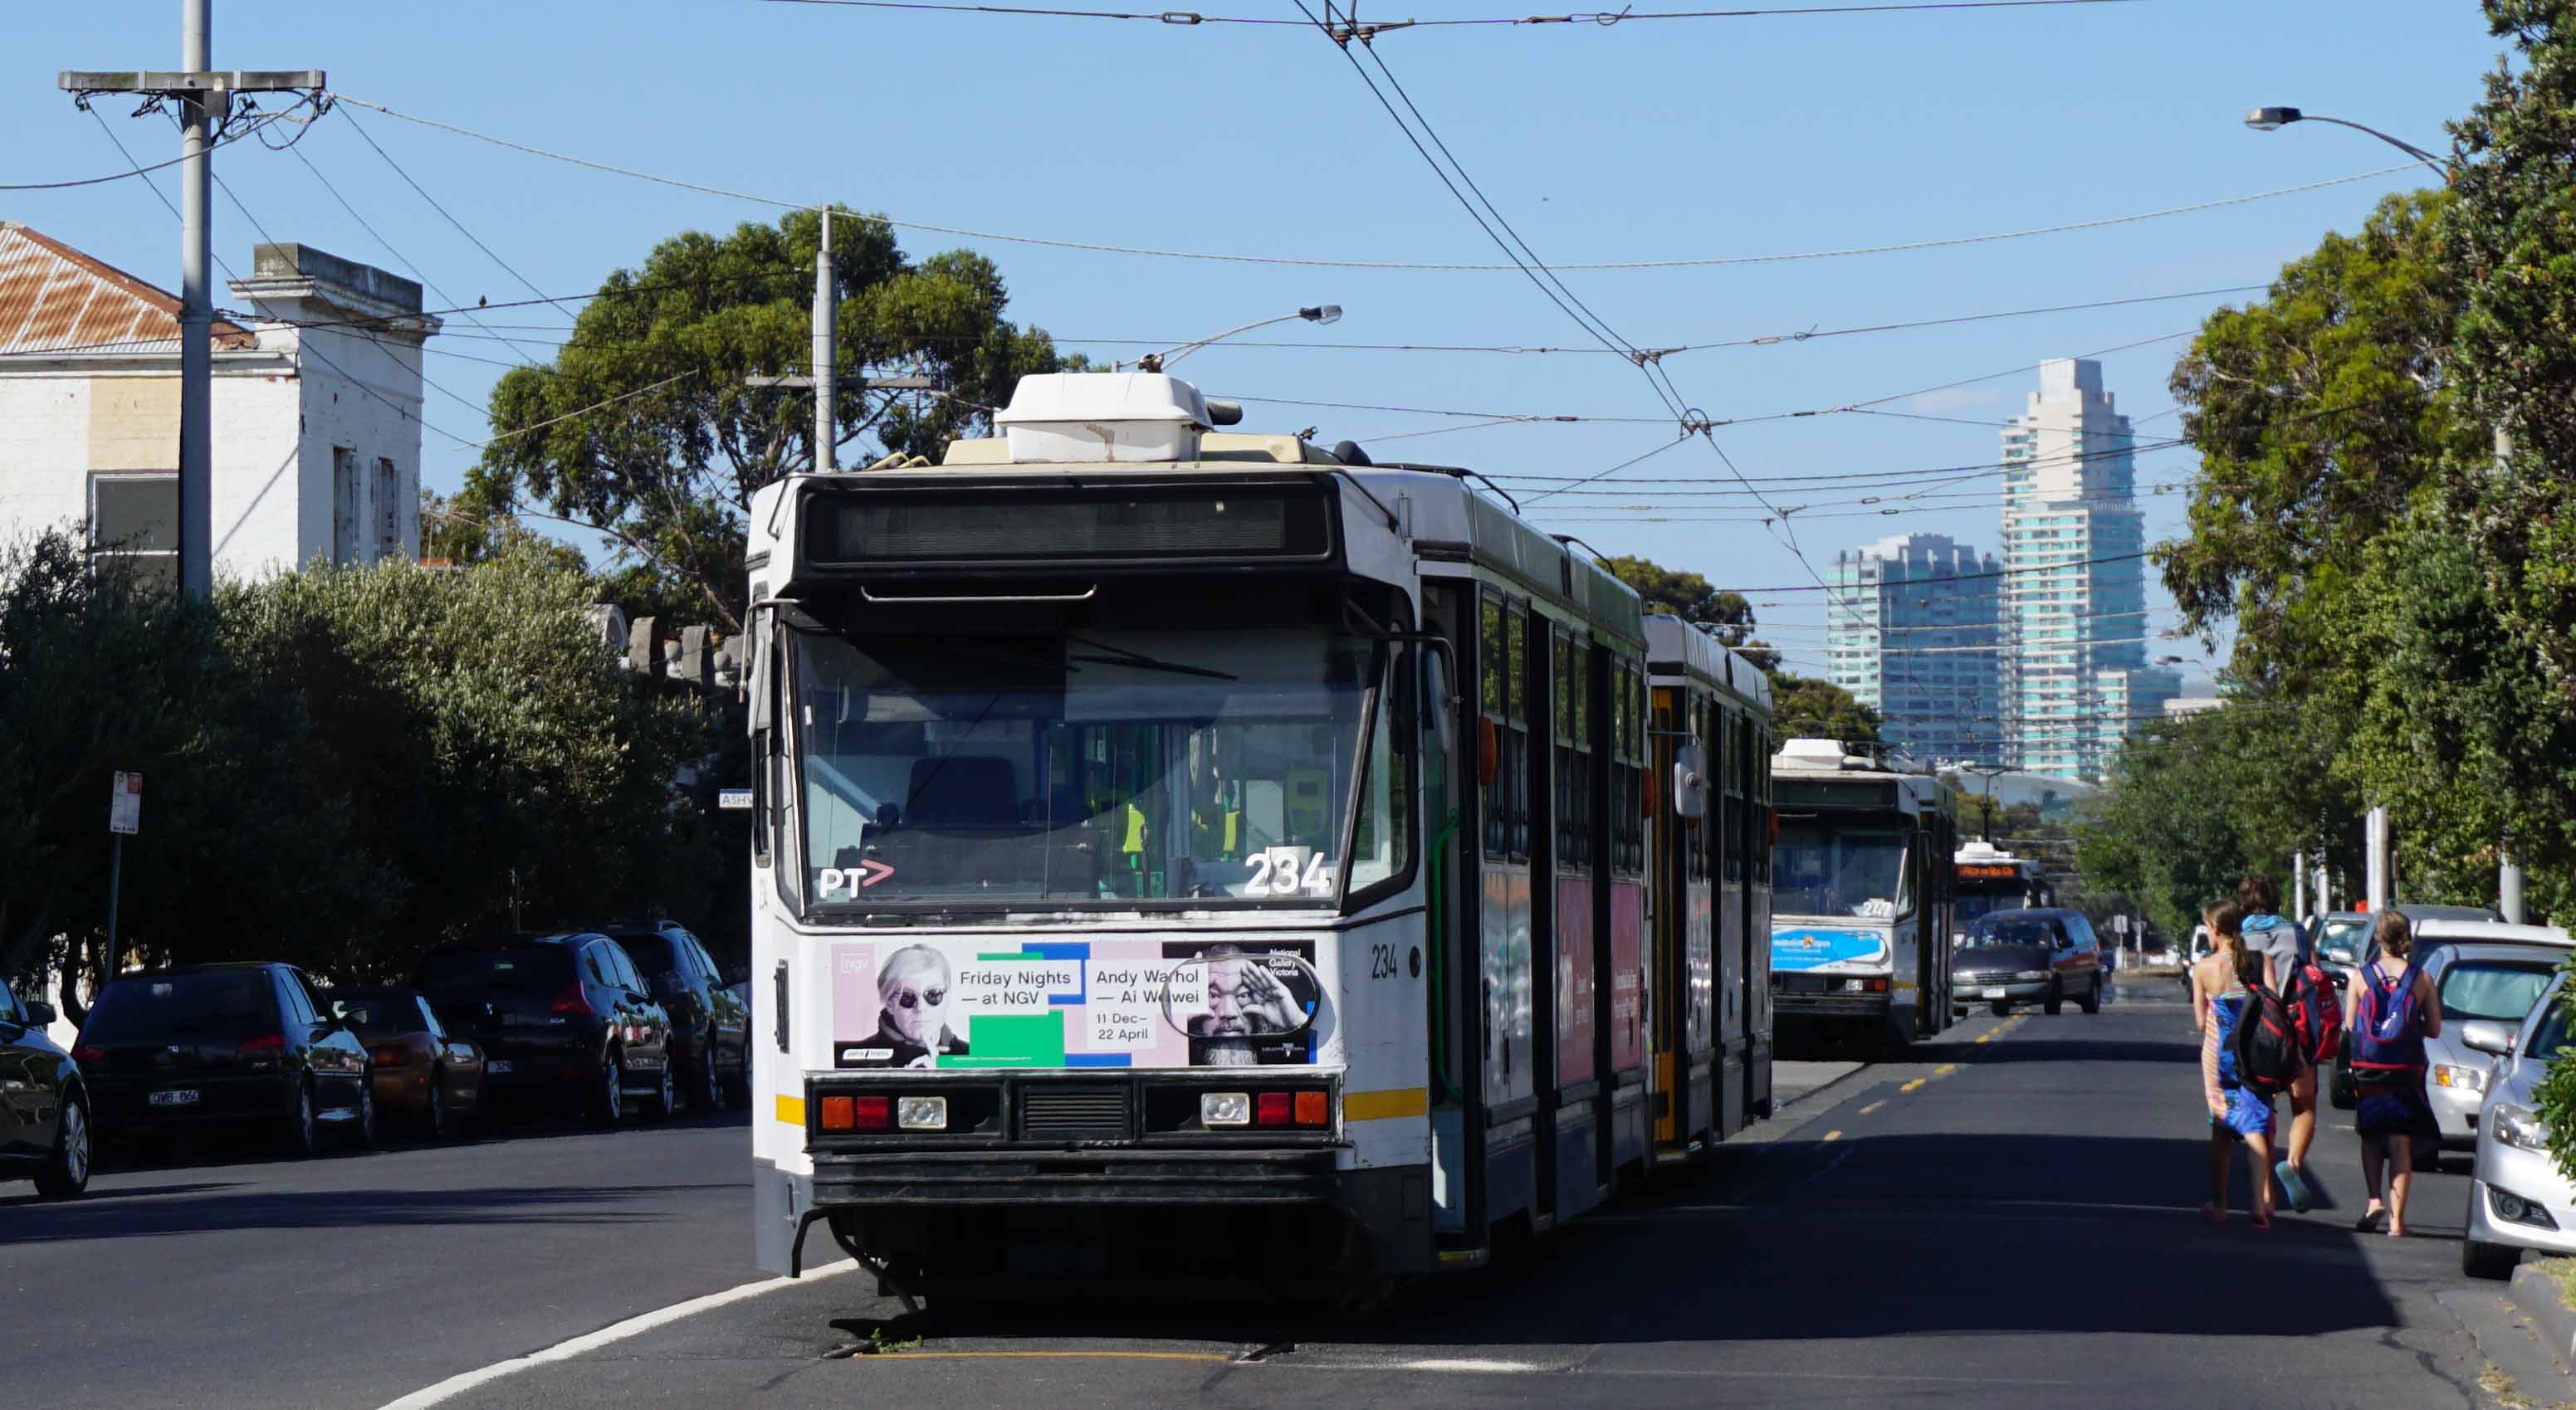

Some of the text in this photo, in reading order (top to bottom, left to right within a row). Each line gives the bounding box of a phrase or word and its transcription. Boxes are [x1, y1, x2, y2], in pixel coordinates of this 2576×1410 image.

[1244, 851, 1330, 895] 234
[1269, 948, 1301, 957] National
[1371, 944, 1398, 979] 234
[960, 970, 1072, 988] Friday Nights
[1096, 969, 1138, 987] Andy
[1269, 968, 1299, 977] Victoria
[982, 993, 998, 1005] at
[1004, 991, 1039, 1005] NGV
[1121, 990, 1136, 1003] Ai
[1097, 1012, 1107, 1023] 11
[1097, 1027, 1149, 1042] 22 April
